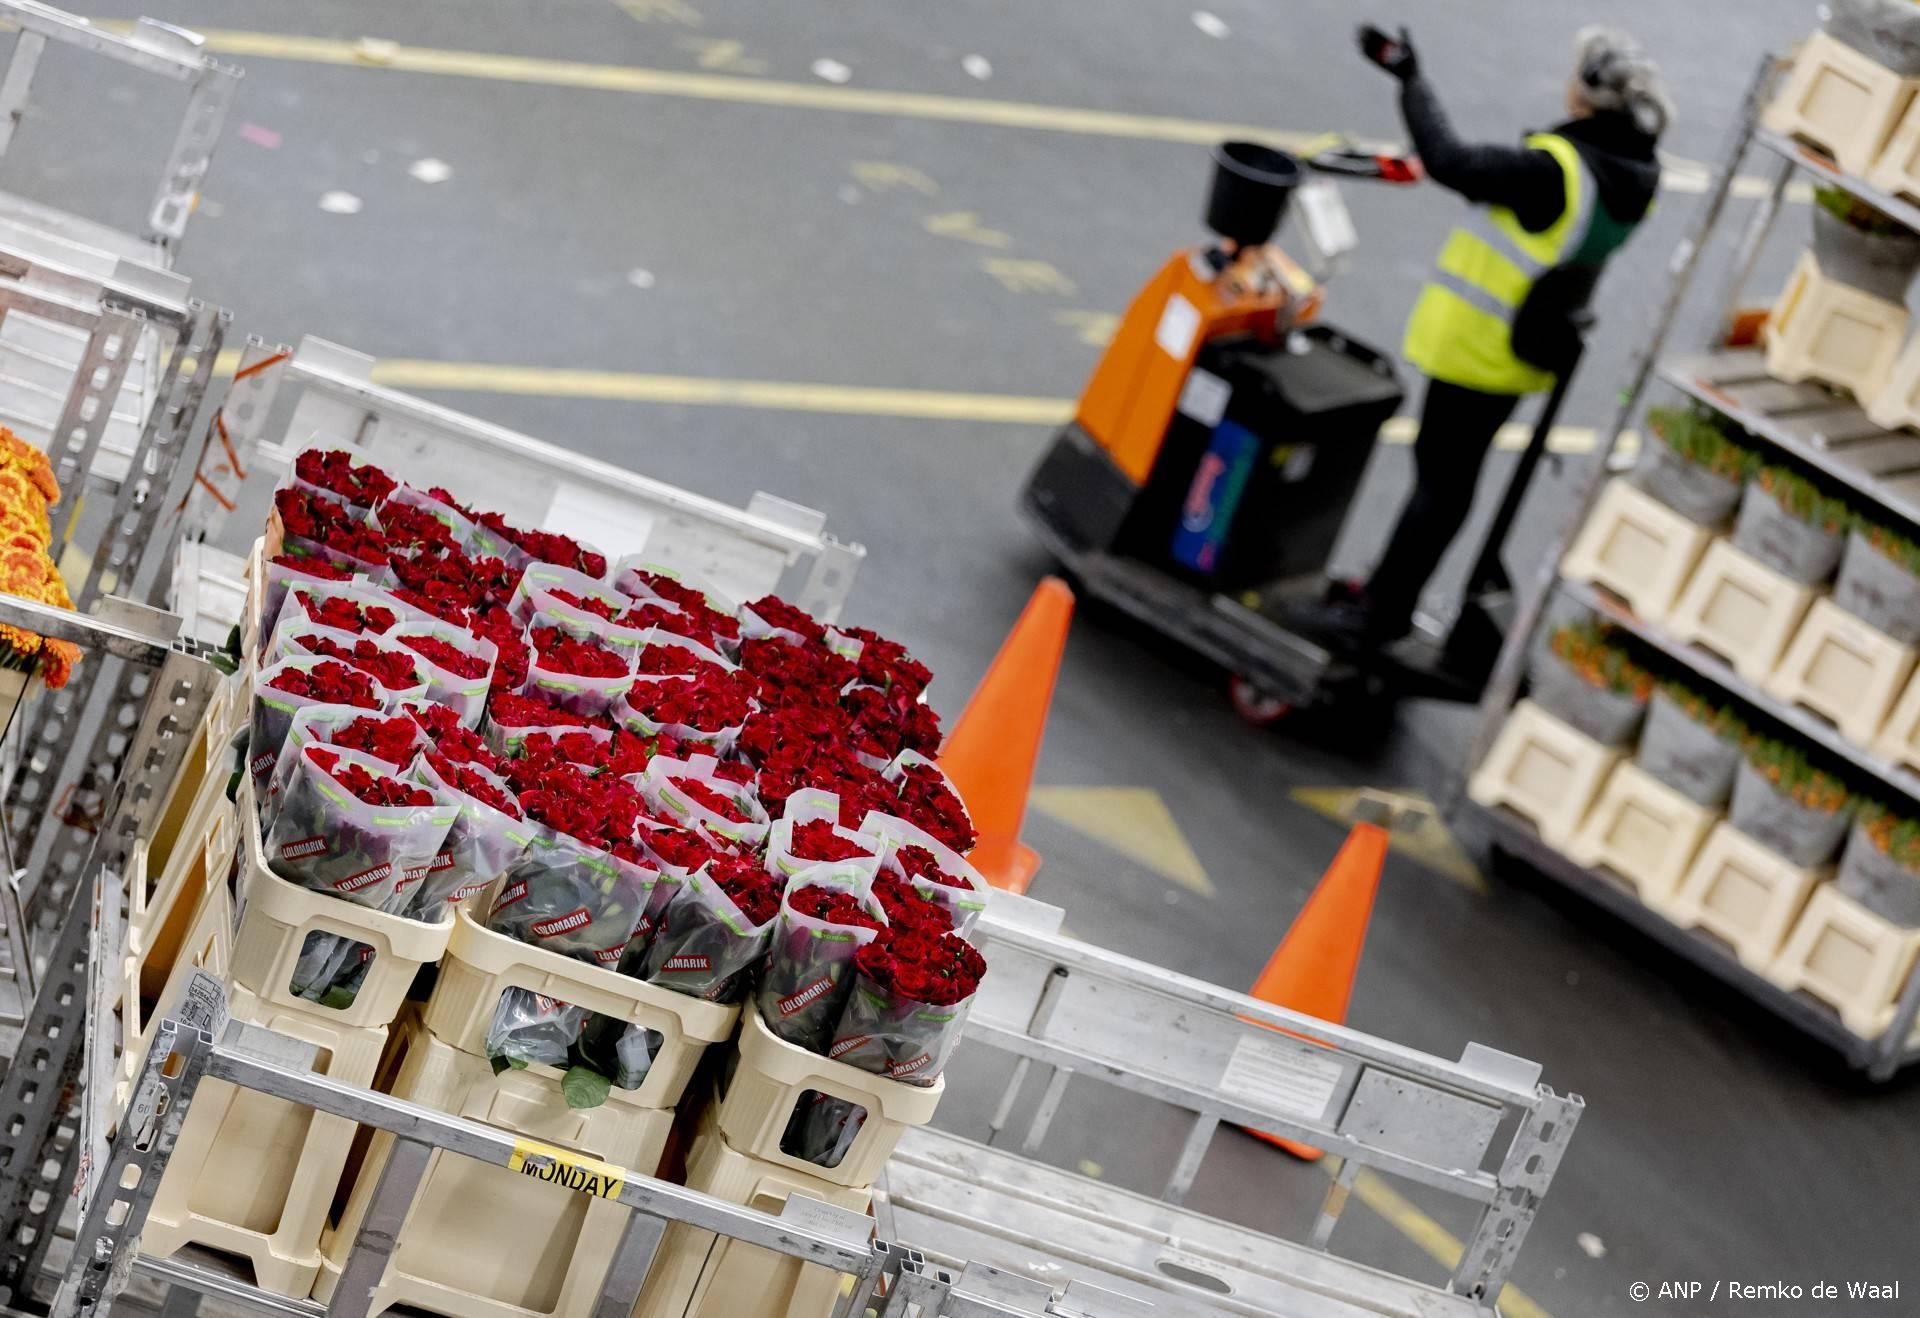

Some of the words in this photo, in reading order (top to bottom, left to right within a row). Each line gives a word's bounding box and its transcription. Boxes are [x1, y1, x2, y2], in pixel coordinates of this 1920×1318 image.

[283, 839, 326, 858] LOLOMARIK
[337, 865, 391, 892] LOLOMARIK
[663, 957, 708, 969] OMARIK
[780, 978, 832, 1014] LOLOMARIK
[889, 1055, 929, 1076] MARIK
[520, 1159, 618, 1199] MONDAY
